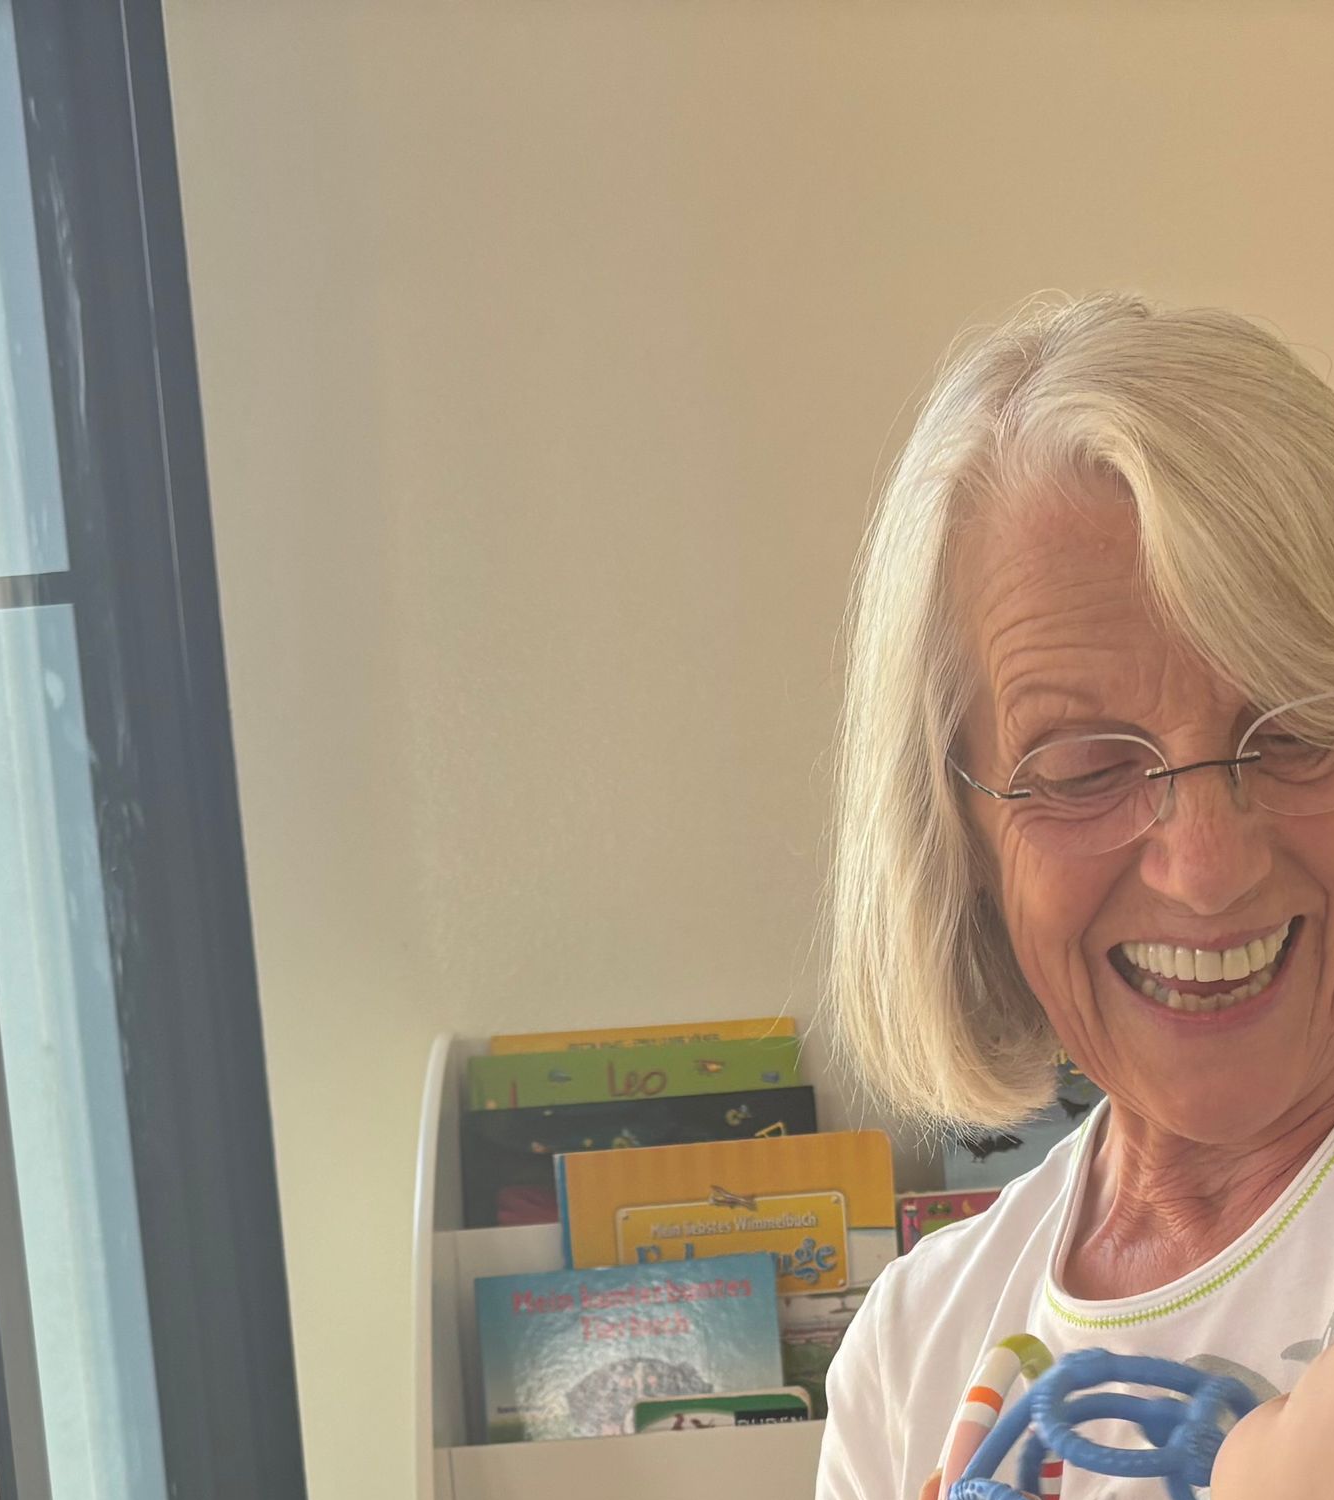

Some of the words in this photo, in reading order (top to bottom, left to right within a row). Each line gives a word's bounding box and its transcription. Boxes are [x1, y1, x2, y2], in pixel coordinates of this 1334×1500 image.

[608, 1059, 667, 1098] Leo
[733, 1211, 817, 1232] Wimmelbuch
[512, 1288, 575, 1314] Mein
[579, 1310, 691, 1342] Tierbuch
